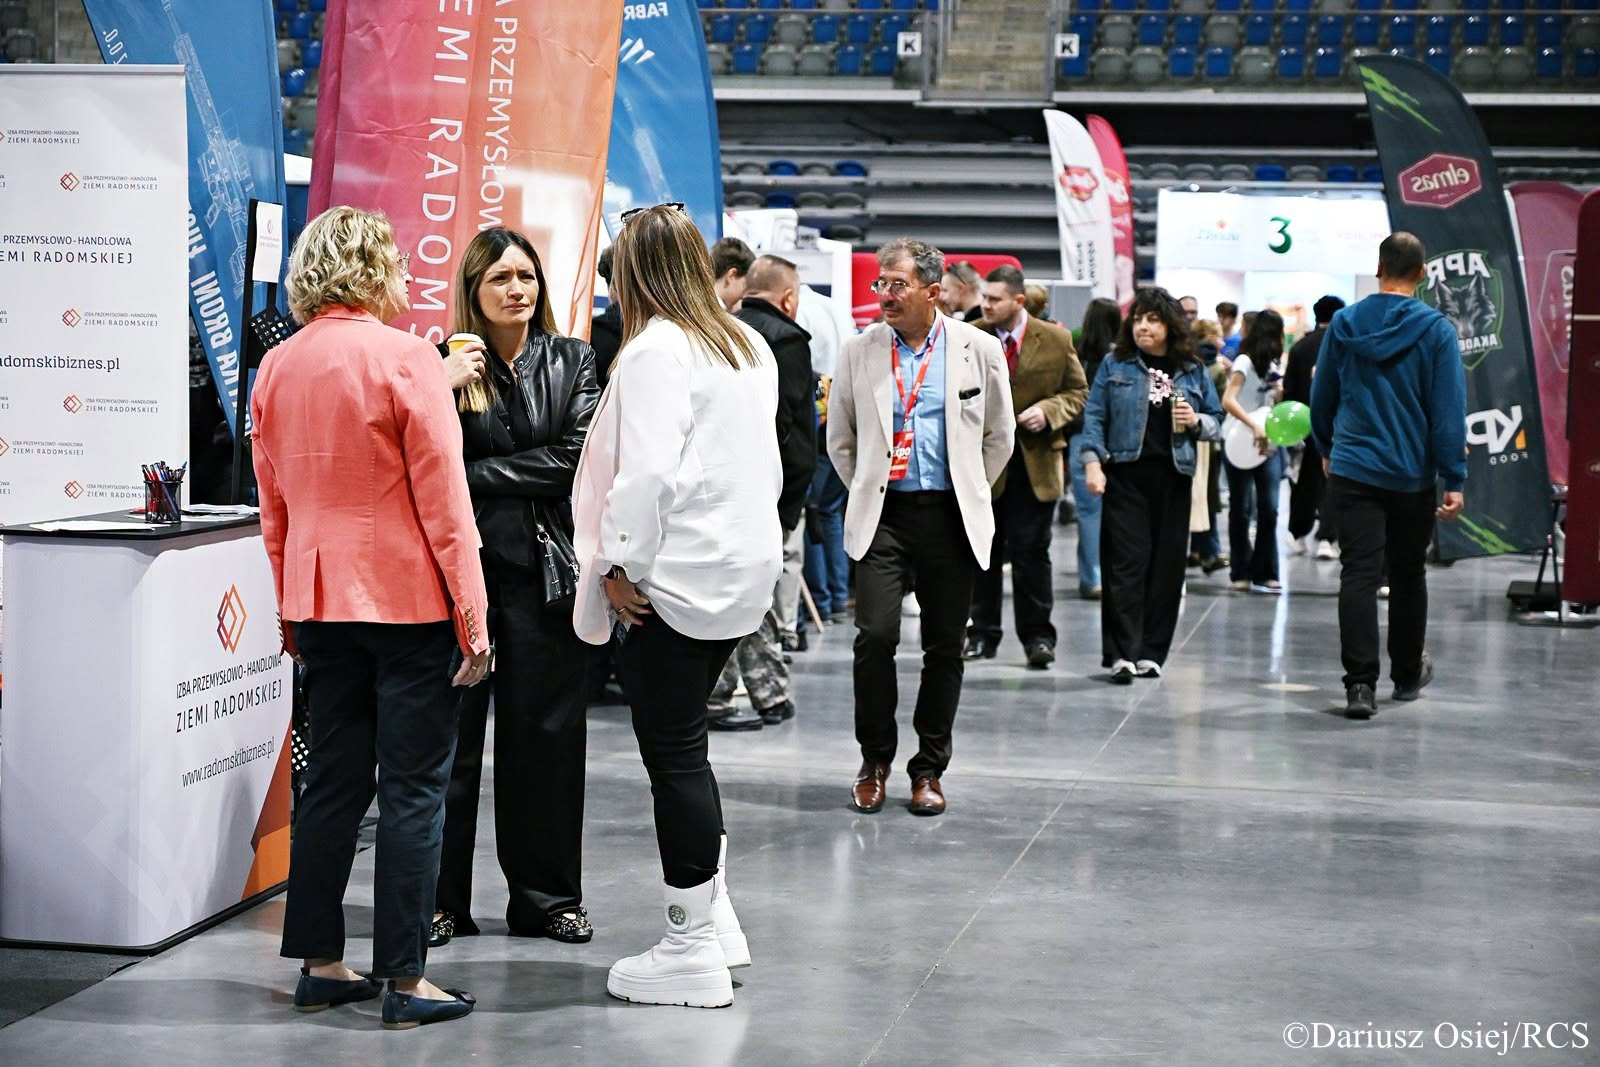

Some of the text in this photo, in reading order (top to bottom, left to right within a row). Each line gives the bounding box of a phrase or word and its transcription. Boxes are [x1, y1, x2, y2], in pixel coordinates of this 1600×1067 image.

[903, 39, 916, 52] K
[1061, 40, 1073, 54] K
[3, 235, 132, 246] PRZEMYSŁOWO-HANDLOWA
[33, 251, 133, 264] RADOMSKIEJ
[37, 448, 84, 456] RADOMSKIEJ
[176, 680, 192, 700] IZBA
[176, 678, 282, 734] ZIEMI RADOMSKIEJ
[182, 736, 275, 788] www.radomskibiznes.pl
